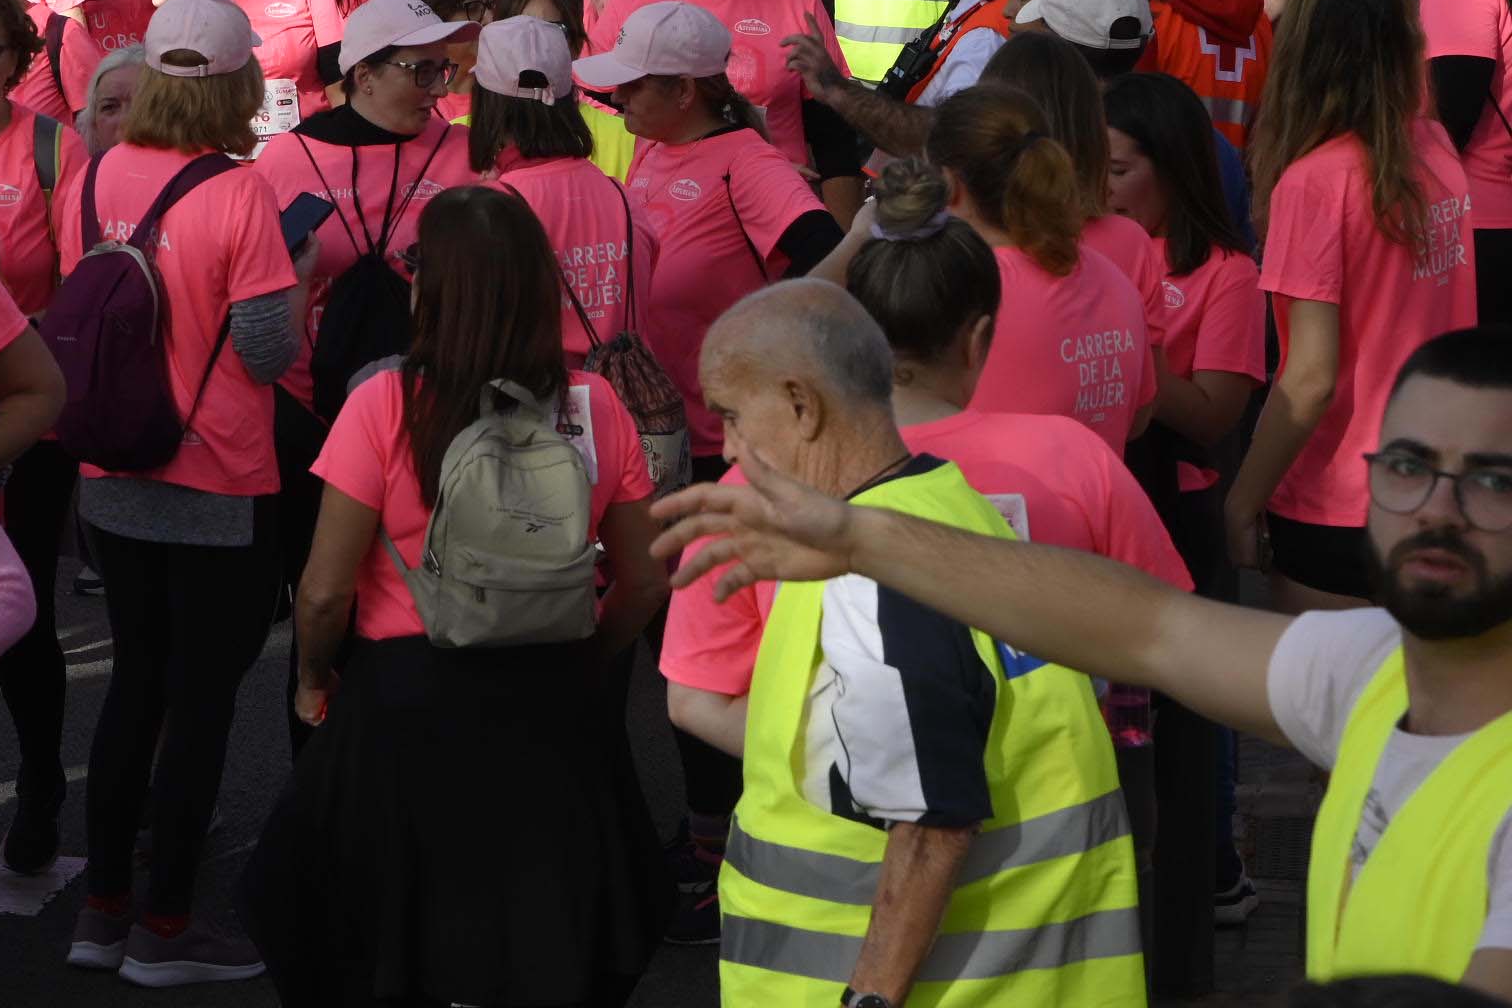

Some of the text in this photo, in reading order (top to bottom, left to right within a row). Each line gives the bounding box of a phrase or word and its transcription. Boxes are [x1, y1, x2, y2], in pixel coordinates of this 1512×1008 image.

[255, 112, 270, 123] 16
[1444, 223, 1461, 246] LA
[554, 239, 628, 267] ARRERA
[1413, 244, 1467, 281] MUJER
[595, 263, 617, 285] LA
[1060, 328, 1135, 363] CARRERA
[1079, 355, 1122, 387] DE LA
[1074, 383, 1125, 414] MUJER
